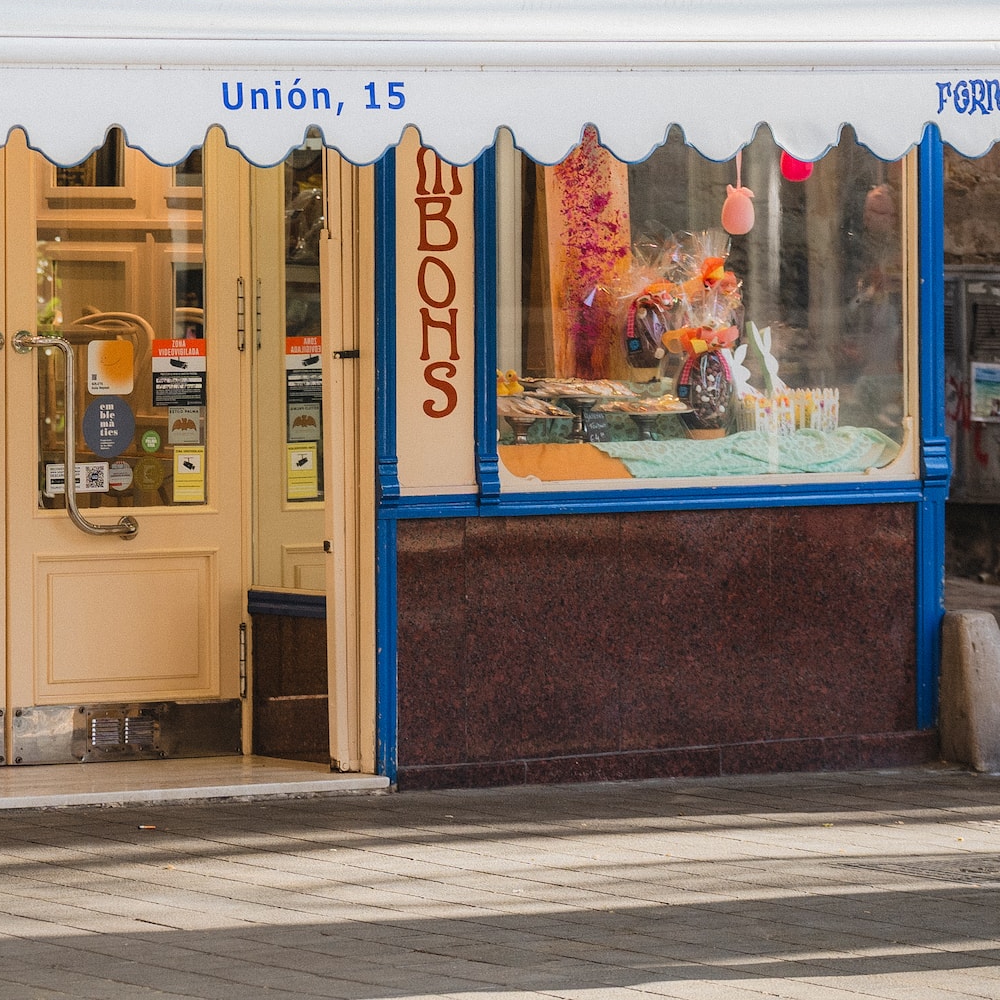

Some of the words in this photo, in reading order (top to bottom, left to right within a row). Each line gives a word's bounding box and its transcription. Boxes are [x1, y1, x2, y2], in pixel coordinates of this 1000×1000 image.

[221, 78, 345, 117] Unión,
[363, 81, 407, 110] 15
[172, 339, 187, 348] ZONA
[158, 347, 200, 356] VIDEOVIGILADA
[99, 403, 115, 411] em
[99, 410, 116, 420] ble
[99, 428, 119, 437] tics
